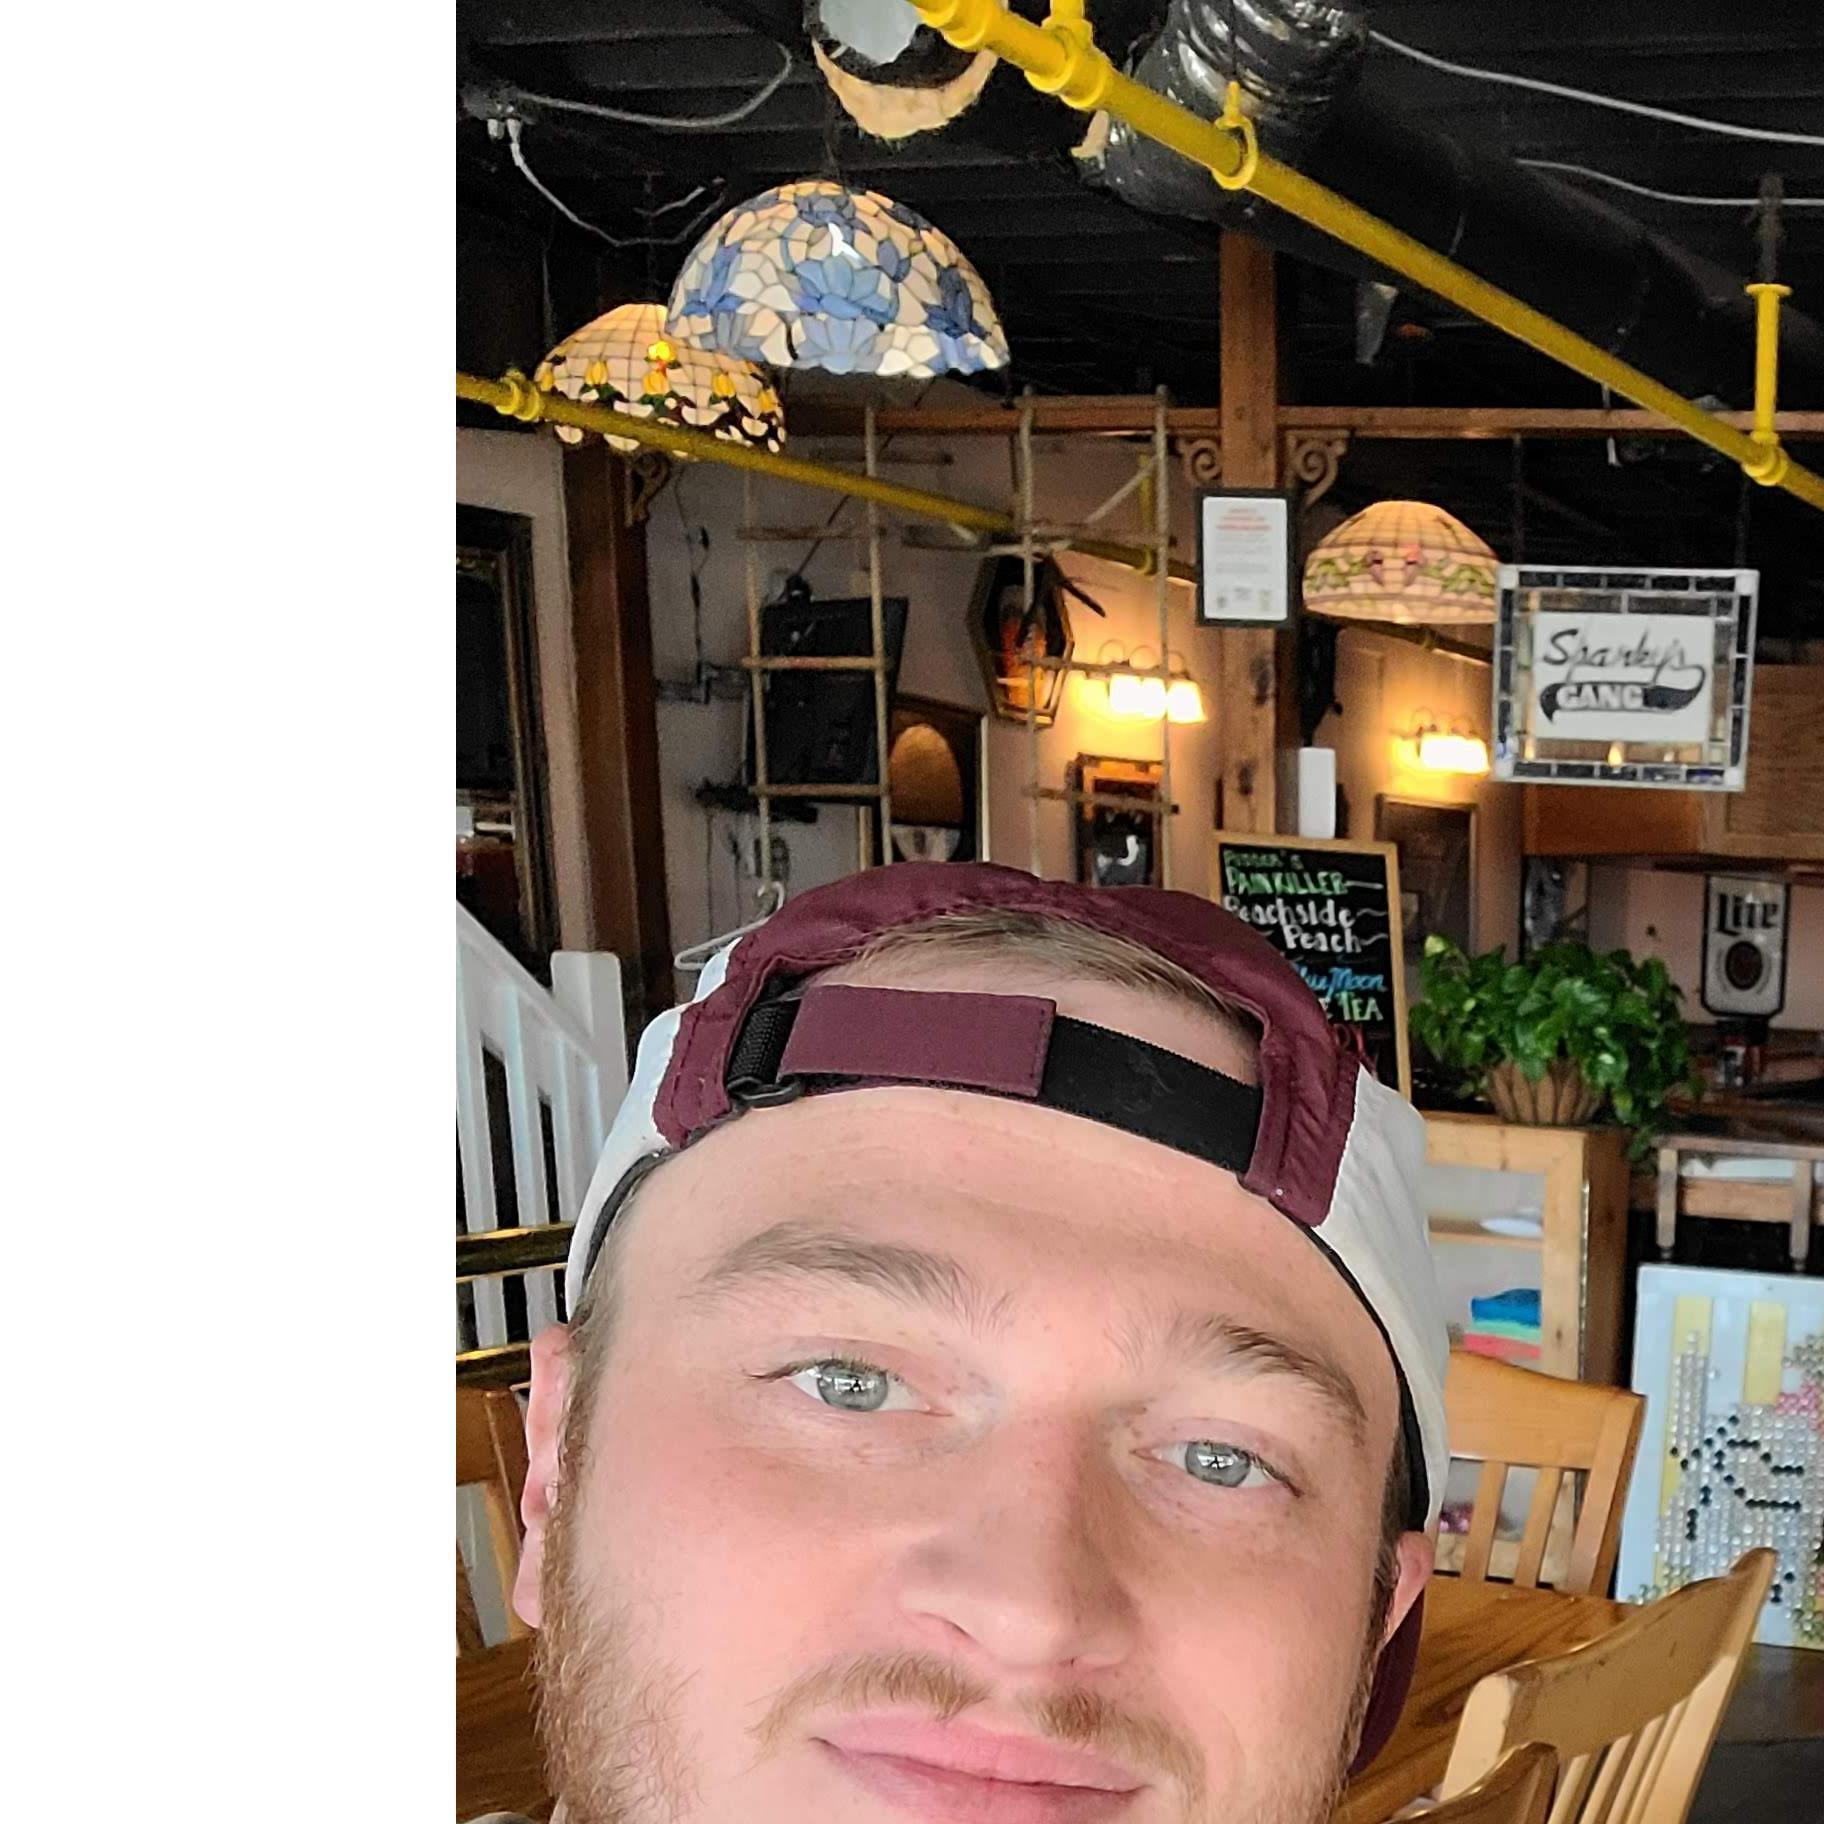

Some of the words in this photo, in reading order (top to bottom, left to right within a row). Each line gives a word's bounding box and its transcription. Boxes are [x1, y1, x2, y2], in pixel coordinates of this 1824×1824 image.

[1226, 866, 1348, 895] PAINKILLER
[1715, 892, 1779, 936] Lite
[1283, 924, 1362, 953] Peach
[1335, 990, 1384, 1021] TEA
